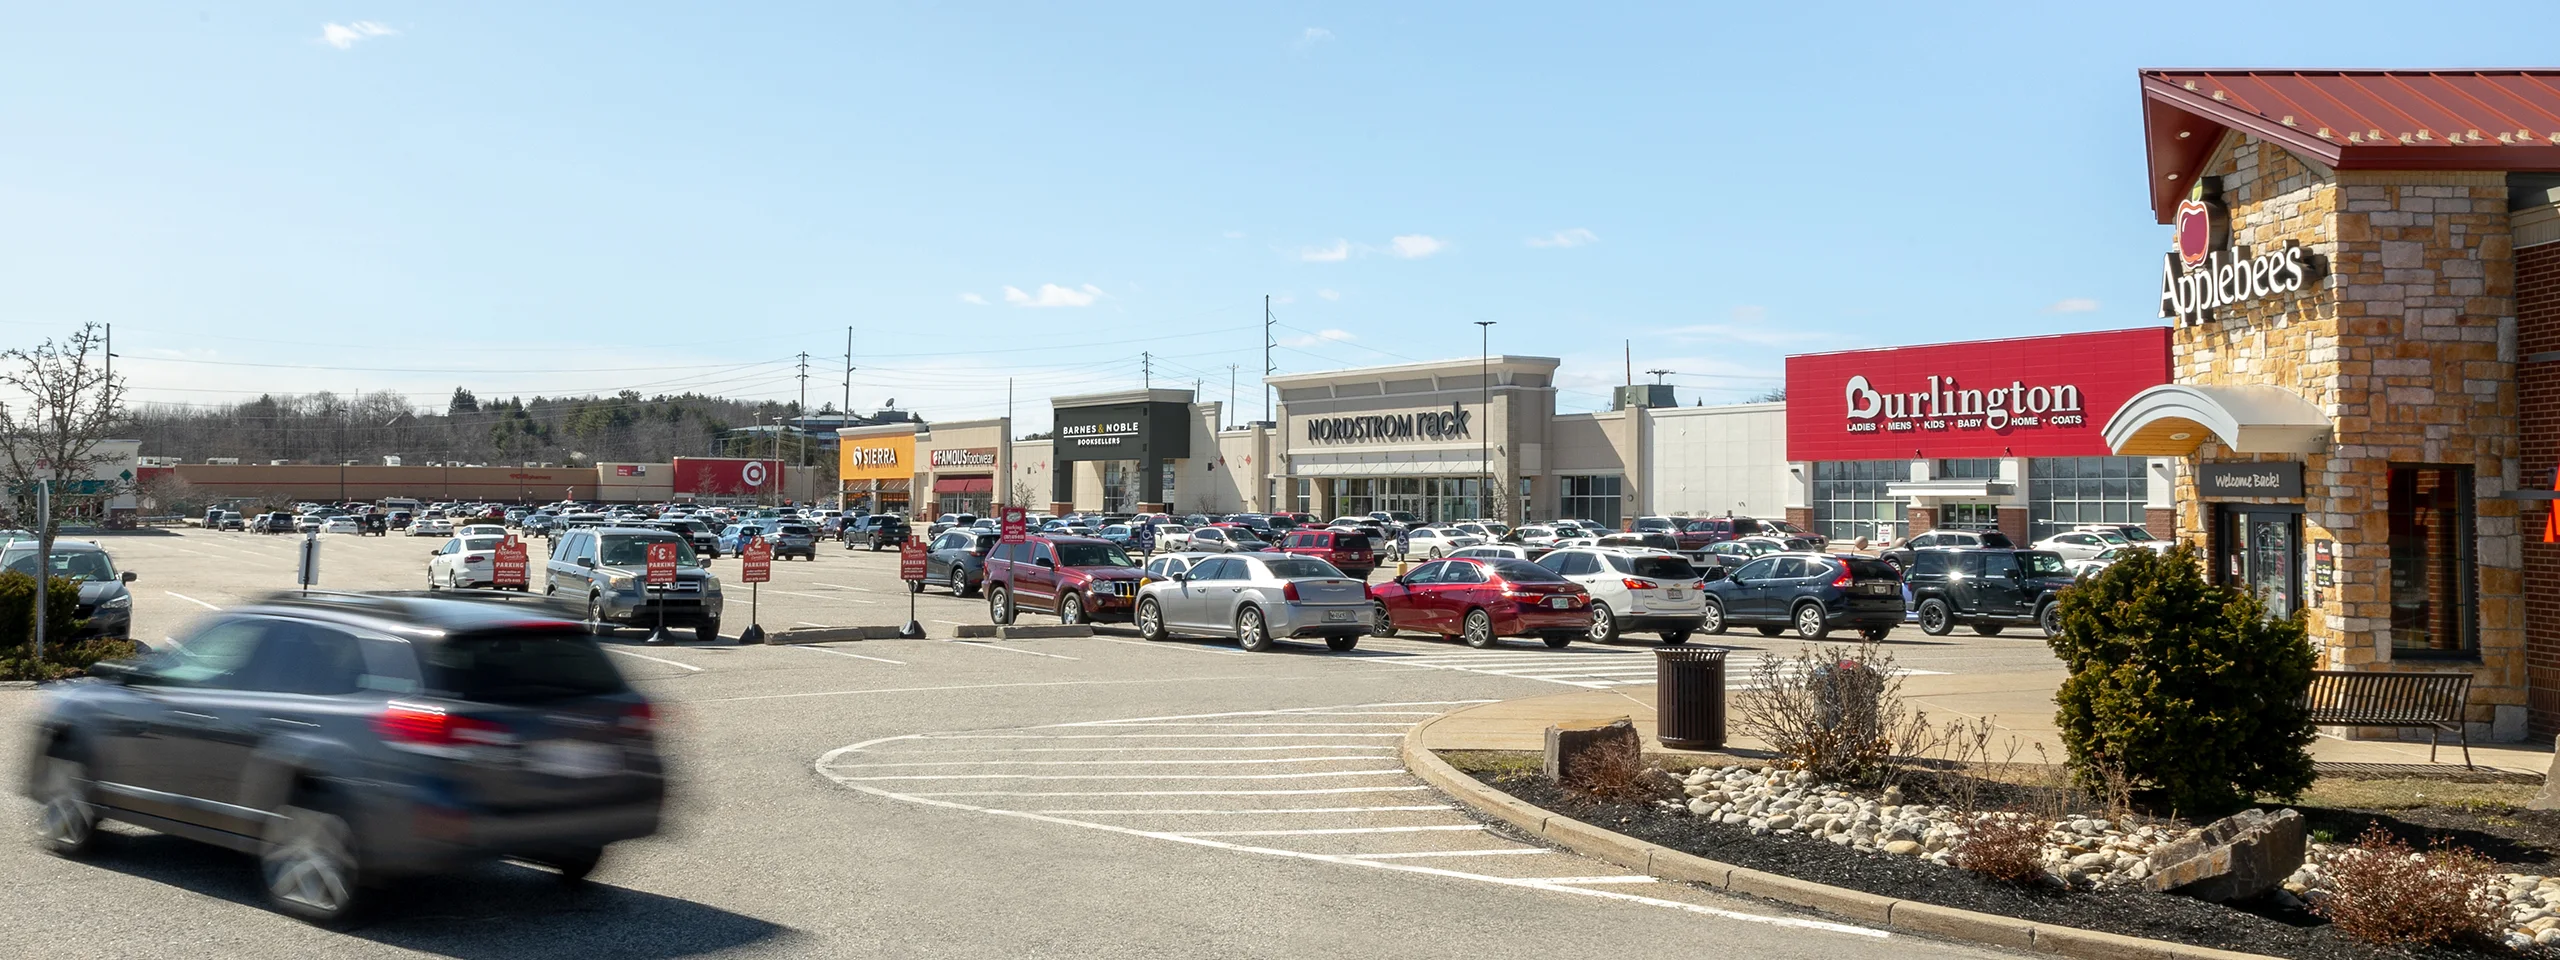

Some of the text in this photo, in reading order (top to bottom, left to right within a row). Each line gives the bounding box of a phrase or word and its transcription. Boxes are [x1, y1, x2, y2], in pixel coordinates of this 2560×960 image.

[2158, 239, 2303, 328] Applebee's
[1845, 375, 2080, 430] Burlington
[1063, 422, 1139, 435] BARNES & NOBLE
[1308, 401, 1471, 440] NORDSTROM rack
[1847, 415, 2082, 432] LADIES MENS KIDS BABY HOME COATS
[1077, 437, 1120, 446] BOOKSELLERS
[862, 447, 897, 465] SIERRA
[938, 449, 995, 466] FAMOUS footwear
[2215, 472, 2280, 488] Welcome Back!
[507, 536, 515, 548] 4
[754, 537, 762, 549] 2
[911, 536, 917, 547] 1
